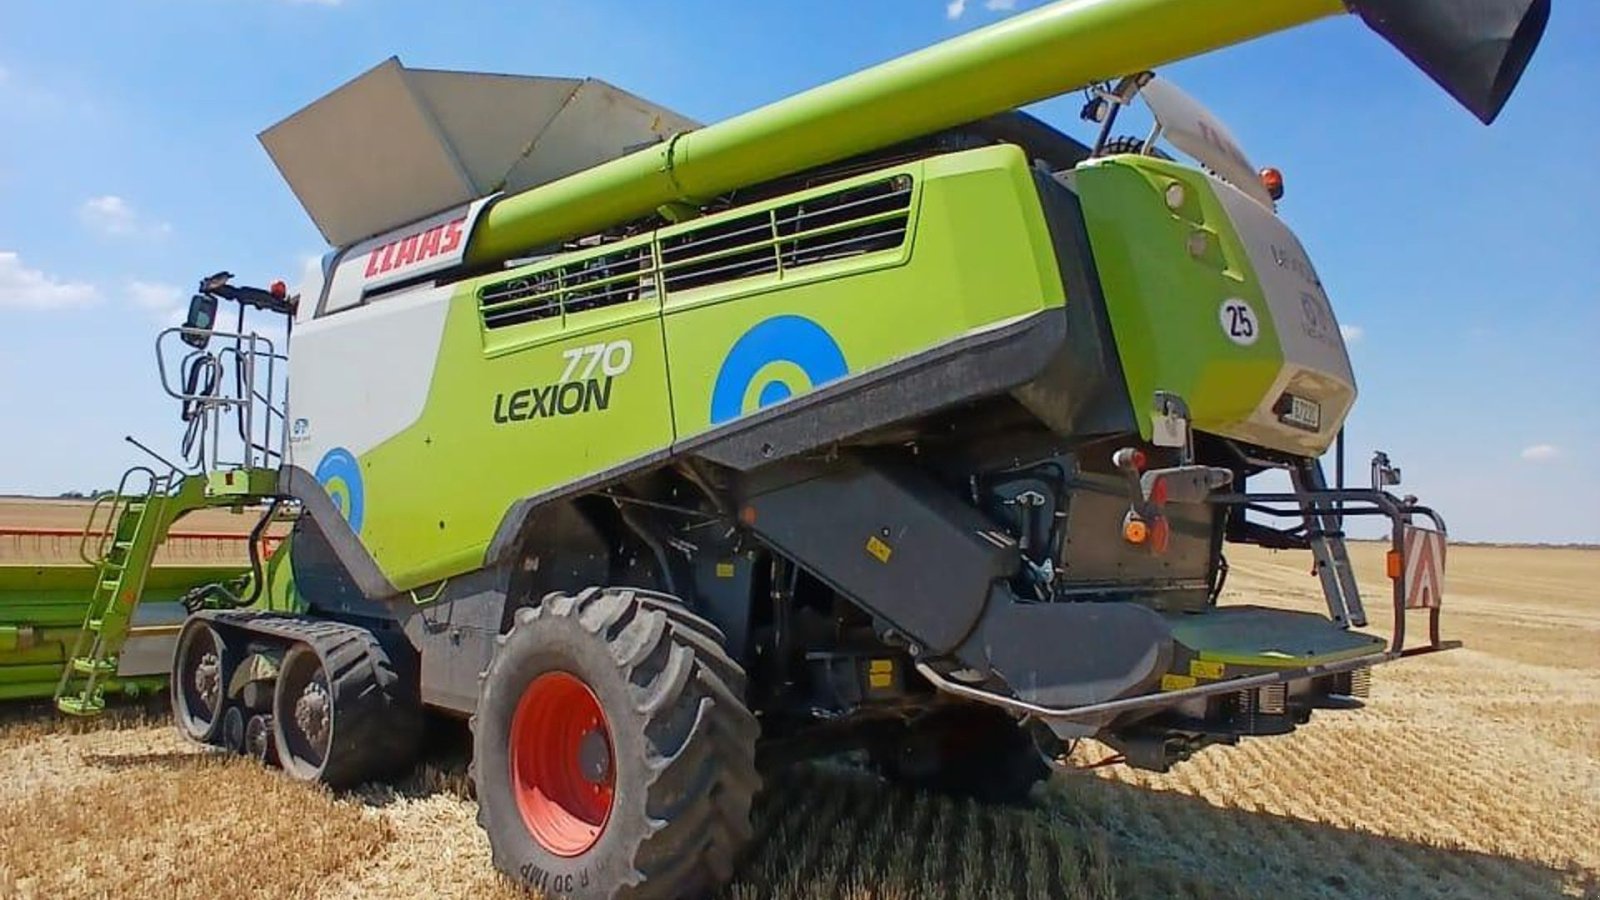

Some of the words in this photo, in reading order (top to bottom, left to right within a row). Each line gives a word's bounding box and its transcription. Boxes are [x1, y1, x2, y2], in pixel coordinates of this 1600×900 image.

[364, 219, 464, 278] CLAAS
[1226, 305, 1254, 338] 25
[561, 339, 633, 382] 770
[494, 376, 613, 424] LEXION
